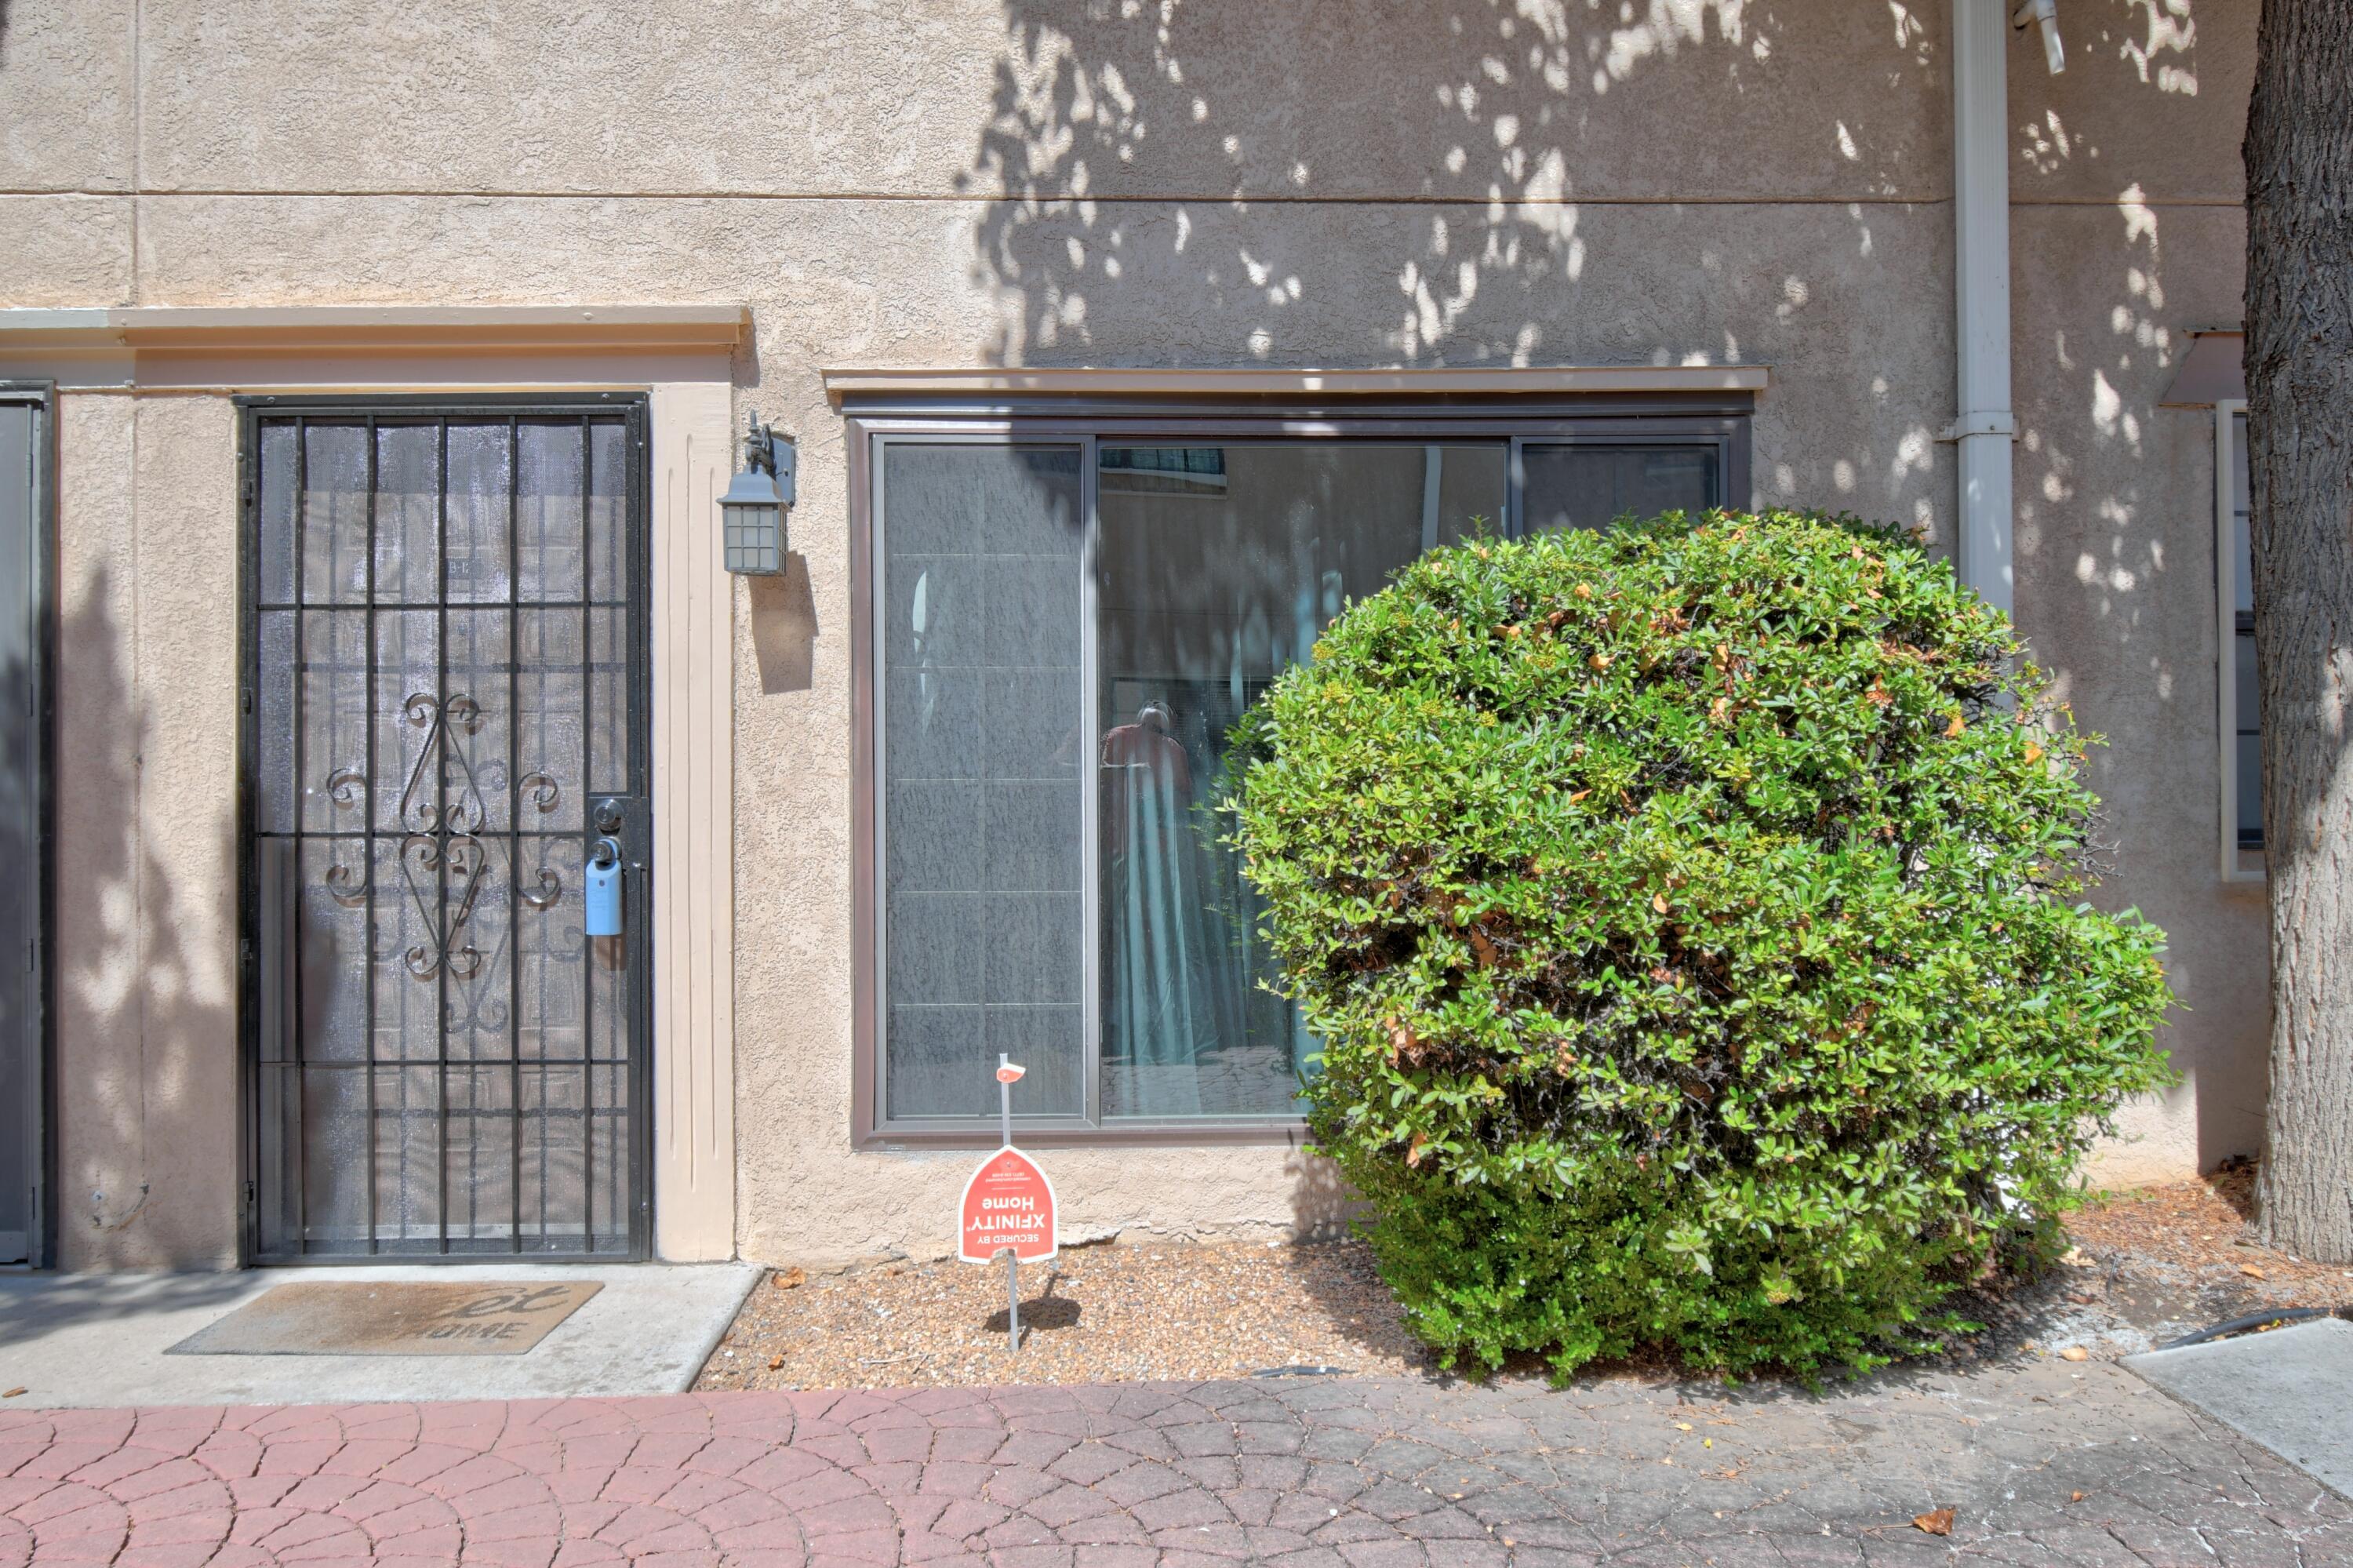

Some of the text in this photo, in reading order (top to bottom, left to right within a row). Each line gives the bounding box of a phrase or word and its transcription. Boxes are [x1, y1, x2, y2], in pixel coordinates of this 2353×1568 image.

[983, 1197, 1034, 1210] Home
[977, 1234, 1039, 1244] SECURED BY
